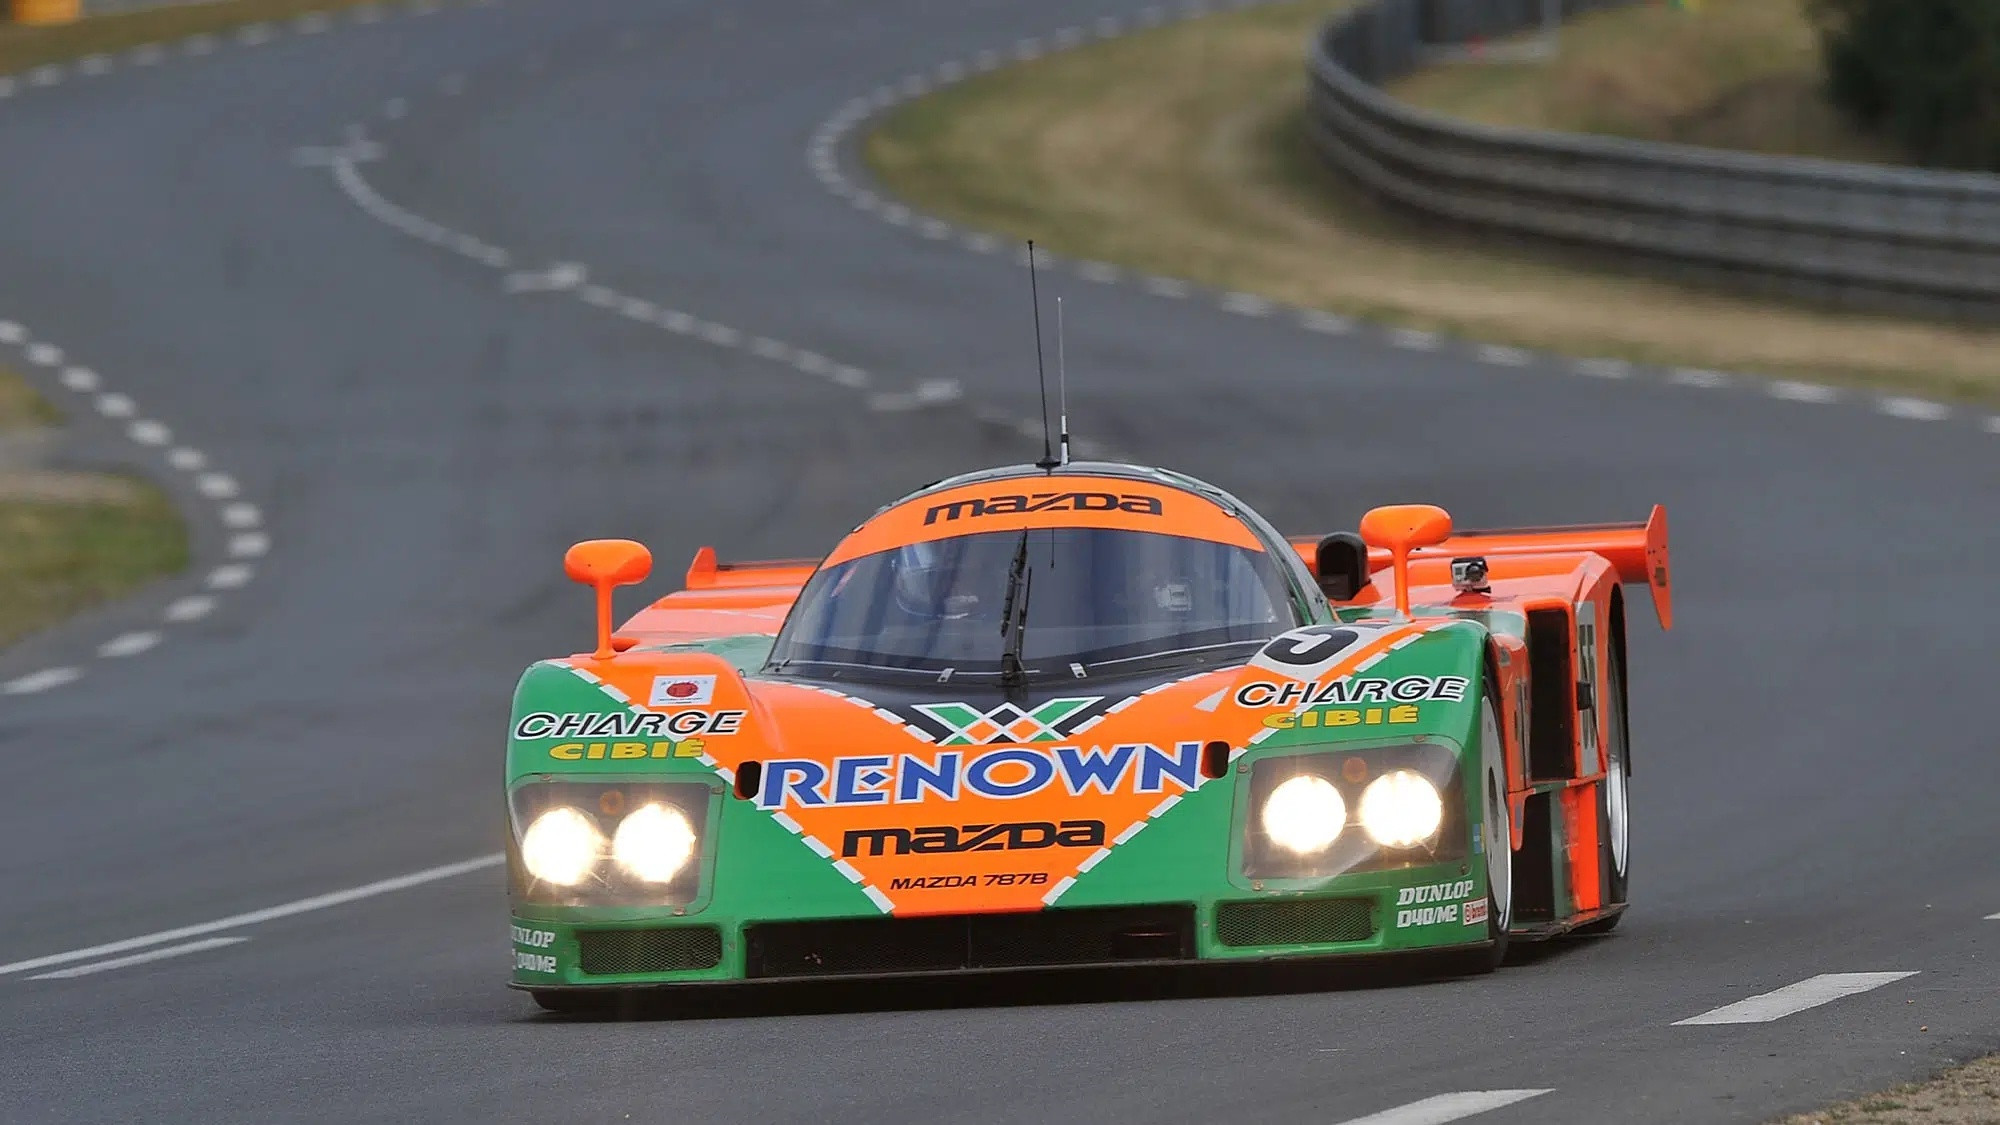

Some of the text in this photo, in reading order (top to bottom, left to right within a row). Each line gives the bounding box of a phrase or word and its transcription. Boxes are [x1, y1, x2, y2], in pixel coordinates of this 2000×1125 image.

[923, 492, 1163, 526] mazda
[1235, 675, 1470, 708] CHARGE
[515, 709, 748, 740] CHARGE
[1261, 704, 1421, 729] CIBIÉ
[549, 738, 706, 761] CIBIÉ
[757, 741, 1205, 810] RENOWN
[841, 819, 1106, 857] mazda
[890, 873, 1048, 890] MAZDA 787B
[1396, 880, 1474, 906] DUNLOP
